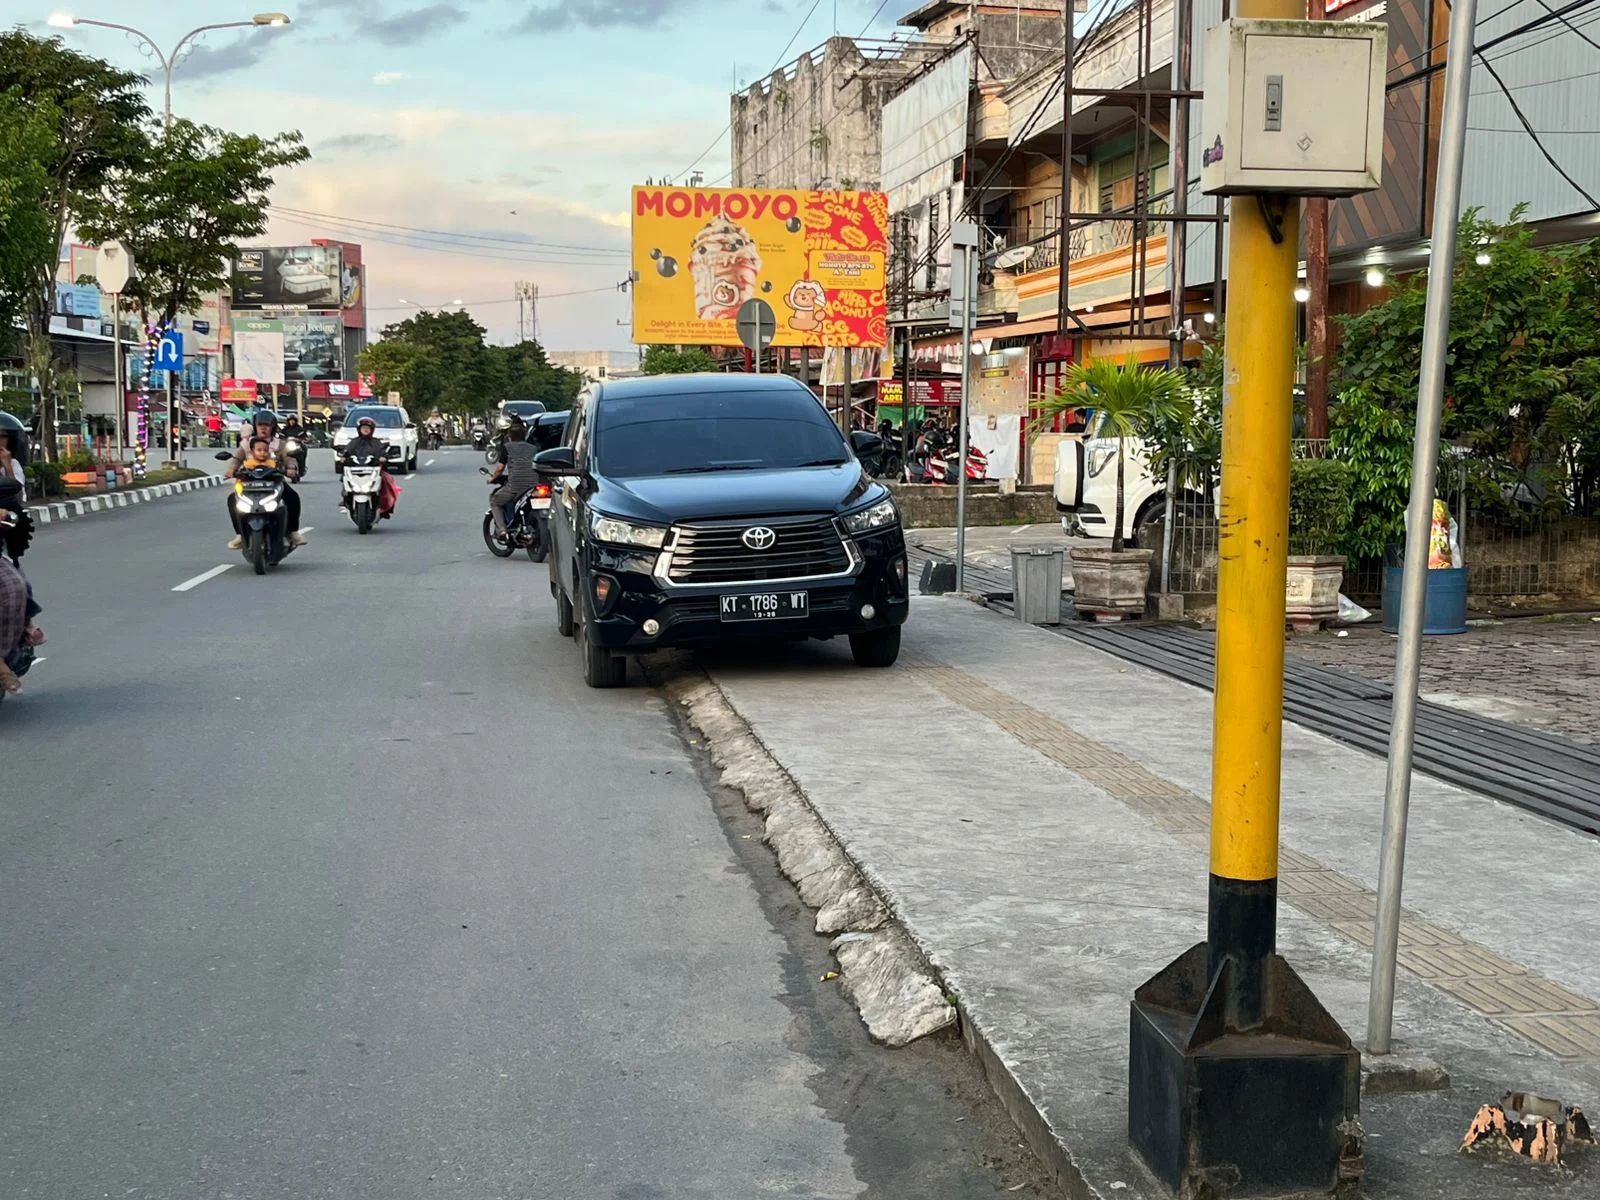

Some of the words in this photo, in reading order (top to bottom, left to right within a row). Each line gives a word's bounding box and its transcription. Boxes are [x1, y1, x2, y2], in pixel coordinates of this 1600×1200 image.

[637, 190, 799, 220] MOMOYO
[824, 202, 864, 226] CONE
[832, 300, 875, 319] DONUT
[650, 320, 676, 328] Delight
[722, 596, 738, 613] KT
[749, 594, 778, 611] 1786
